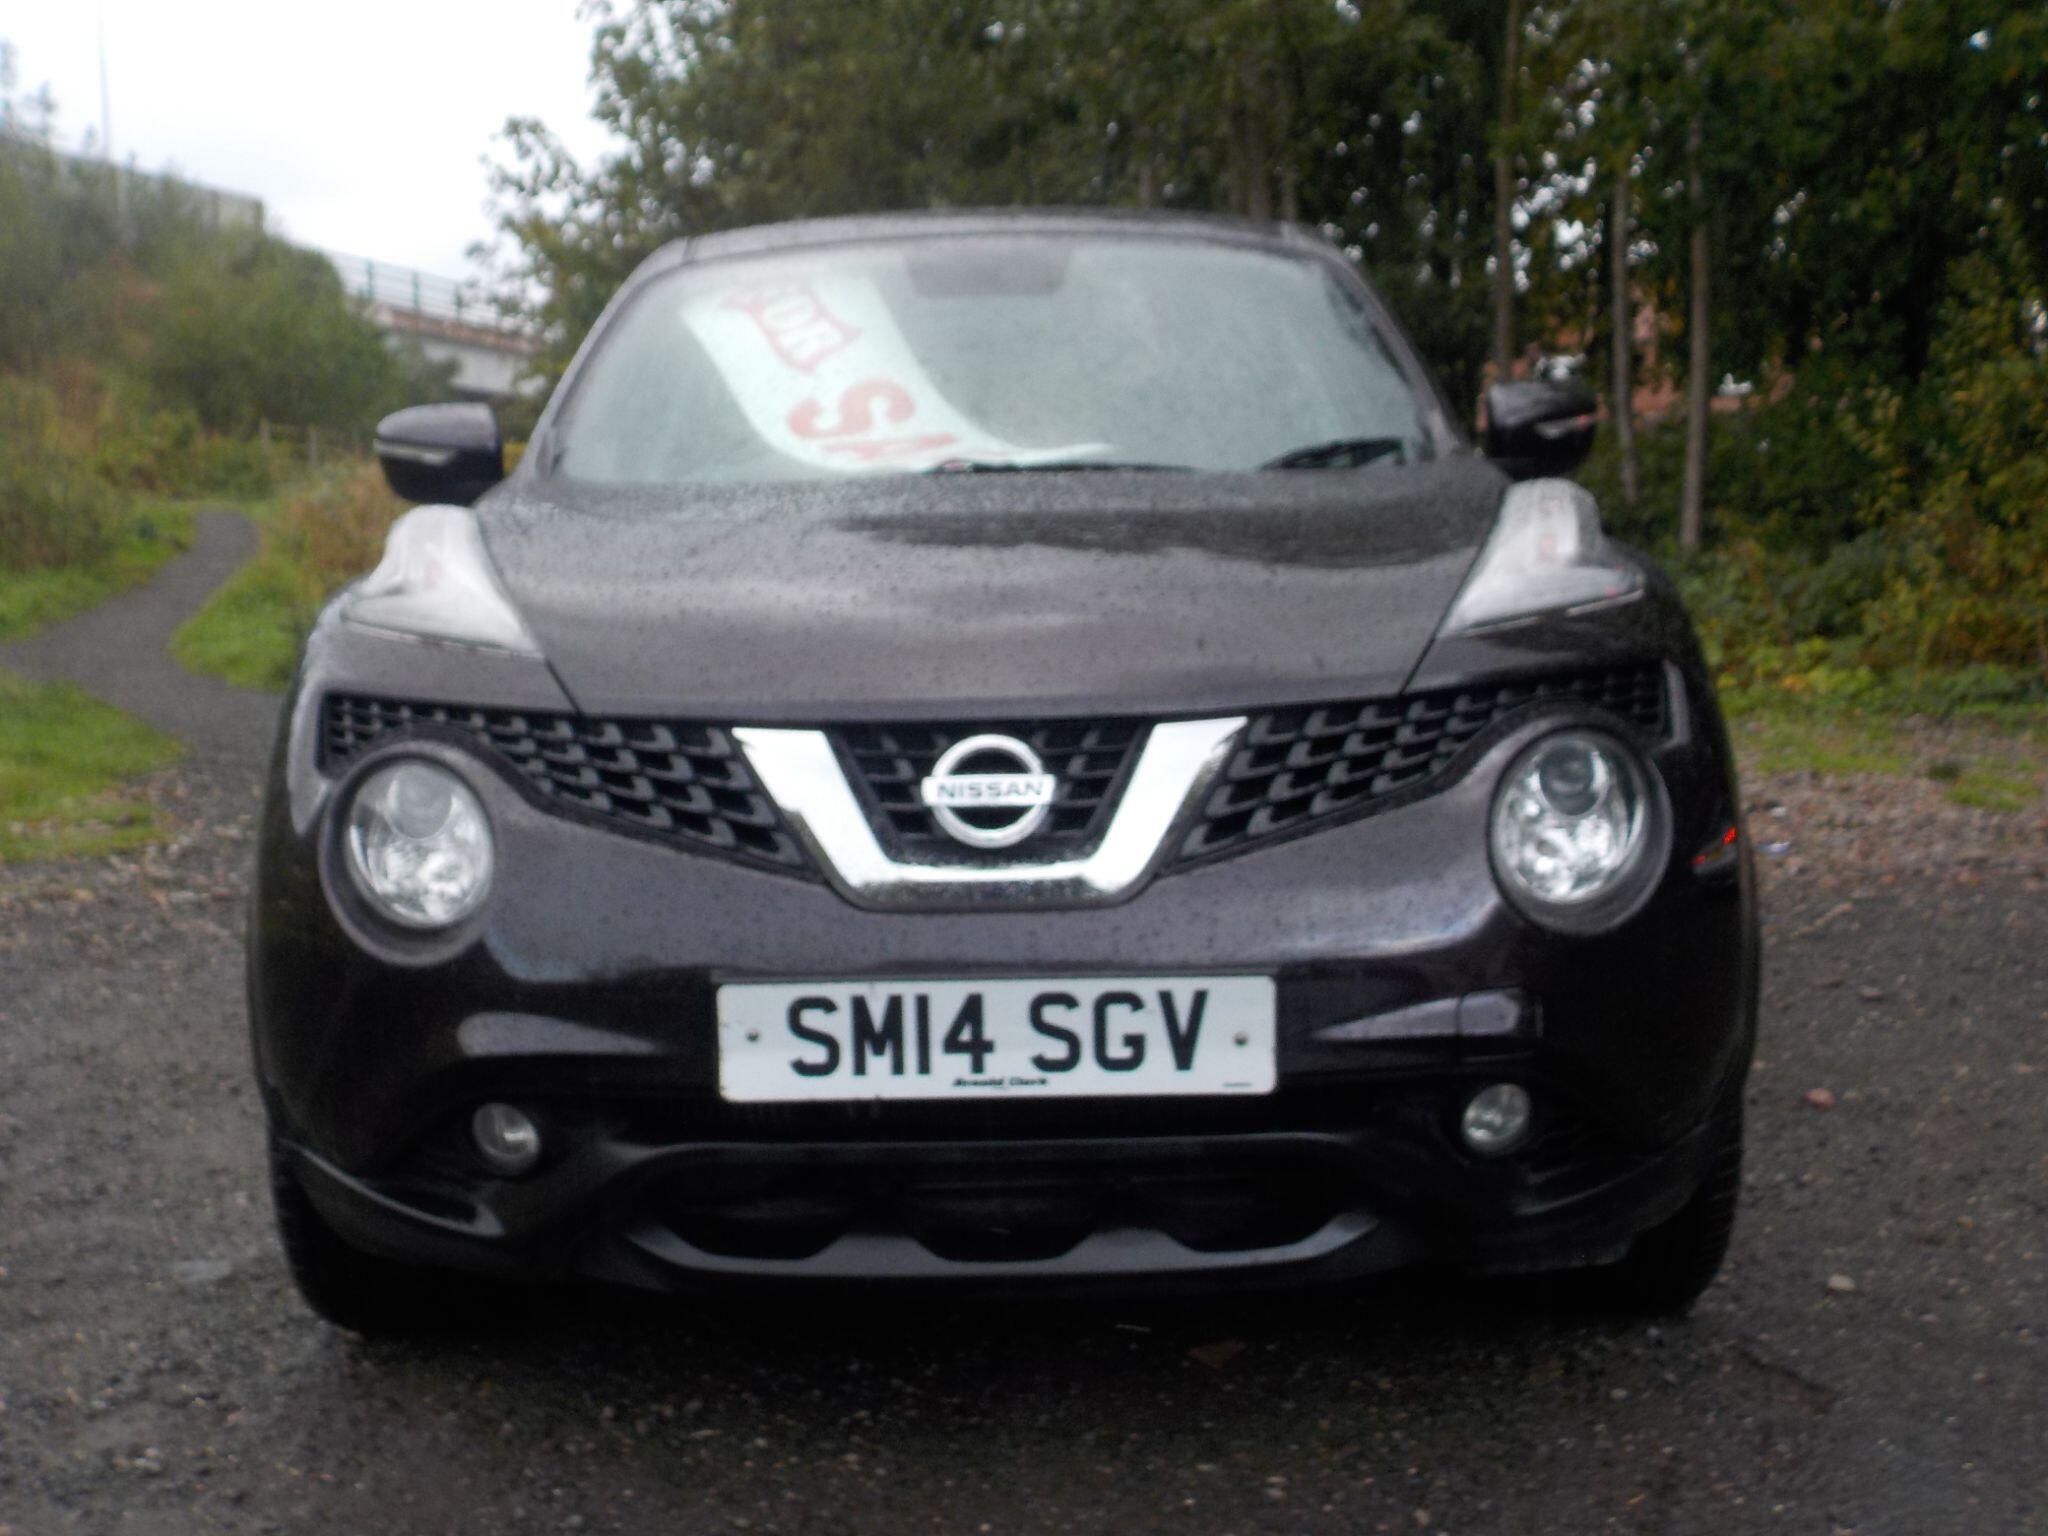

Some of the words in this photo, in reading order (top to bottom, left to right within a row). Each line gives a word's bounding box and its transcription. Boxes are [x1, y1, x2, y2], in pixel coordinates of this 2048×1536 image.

[937, 781, 1044, 799] NISSAN
[787, 993, 995, 1077] SM14
[1028, 990, 1208, 1073] SGV
